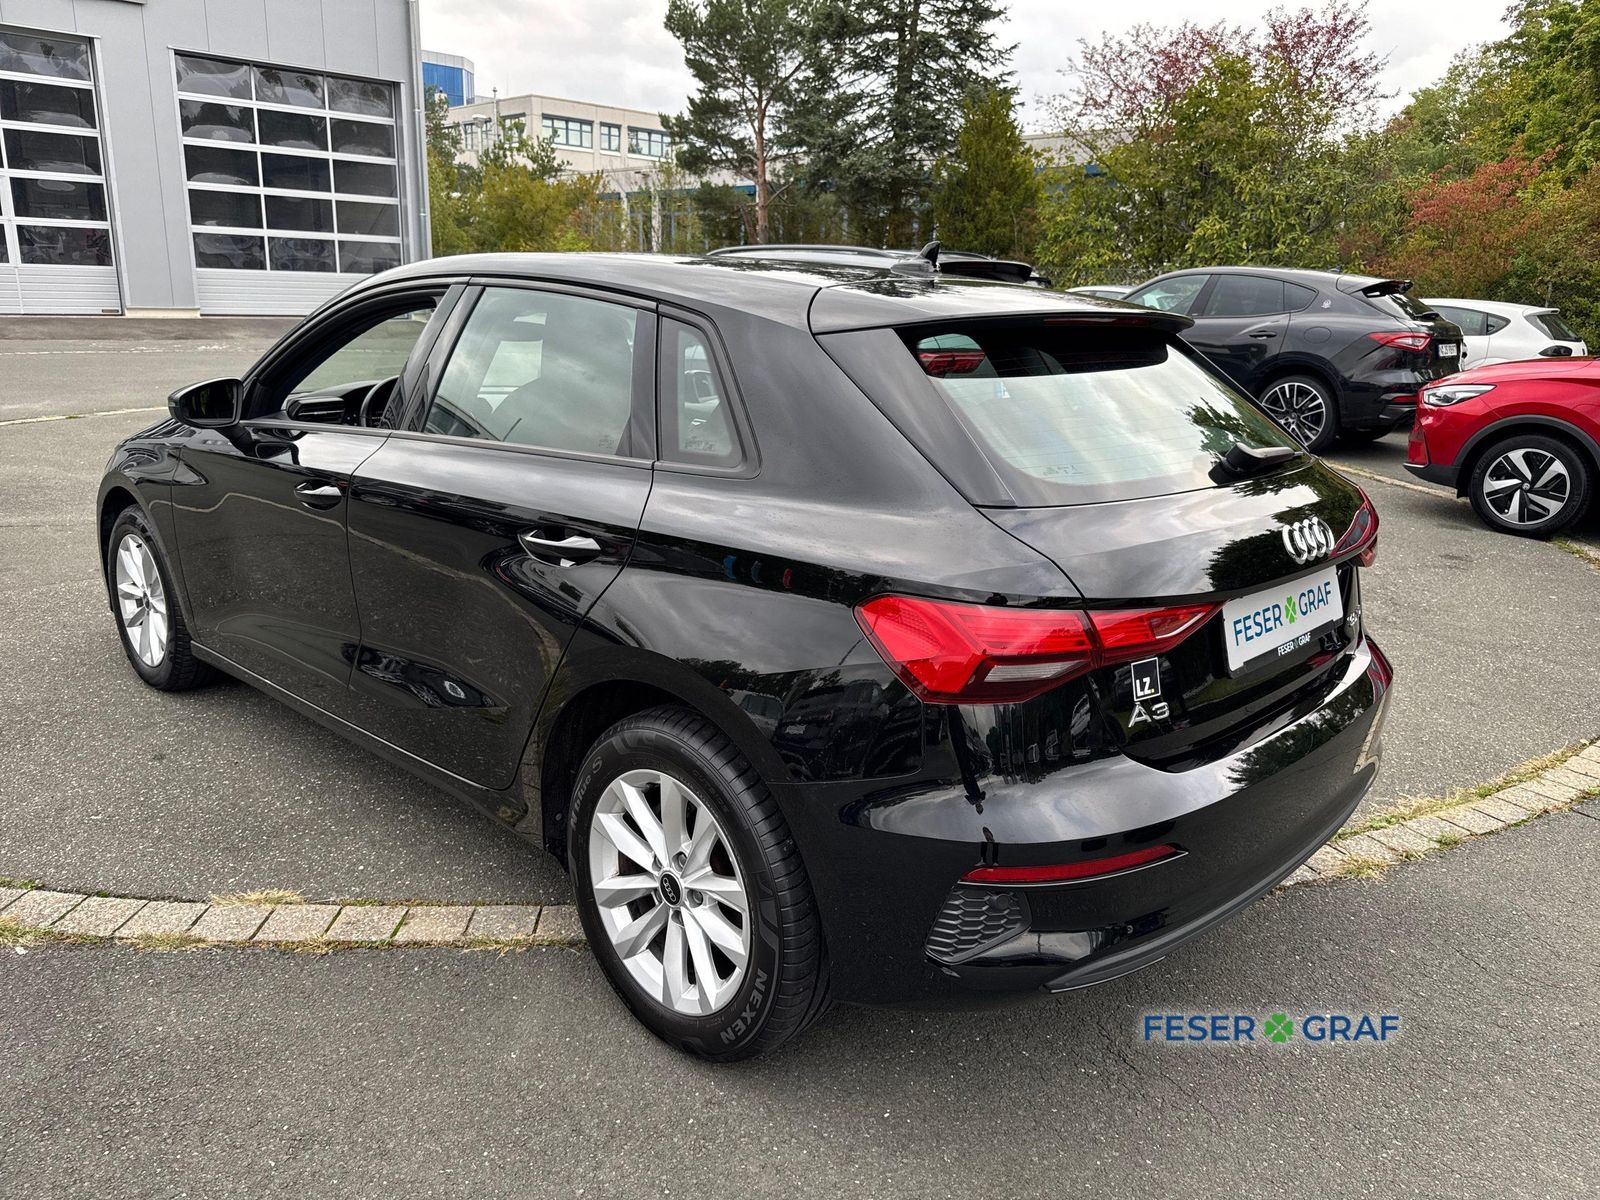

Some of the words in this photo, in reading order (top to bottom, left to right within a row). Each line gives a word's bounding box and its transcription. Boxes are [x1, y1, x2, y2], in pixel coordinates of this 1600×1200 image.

[1233, 603, 1283, 646] FESER
[1298, 581, 1332, 616] GRAF
[1277, 641, 1294, 656] FESER
[1298, 632, 1312, 647] GRAF
[1128, 701, 1170, 728] A3
[720, 967, 768, 1044] NEXEN
